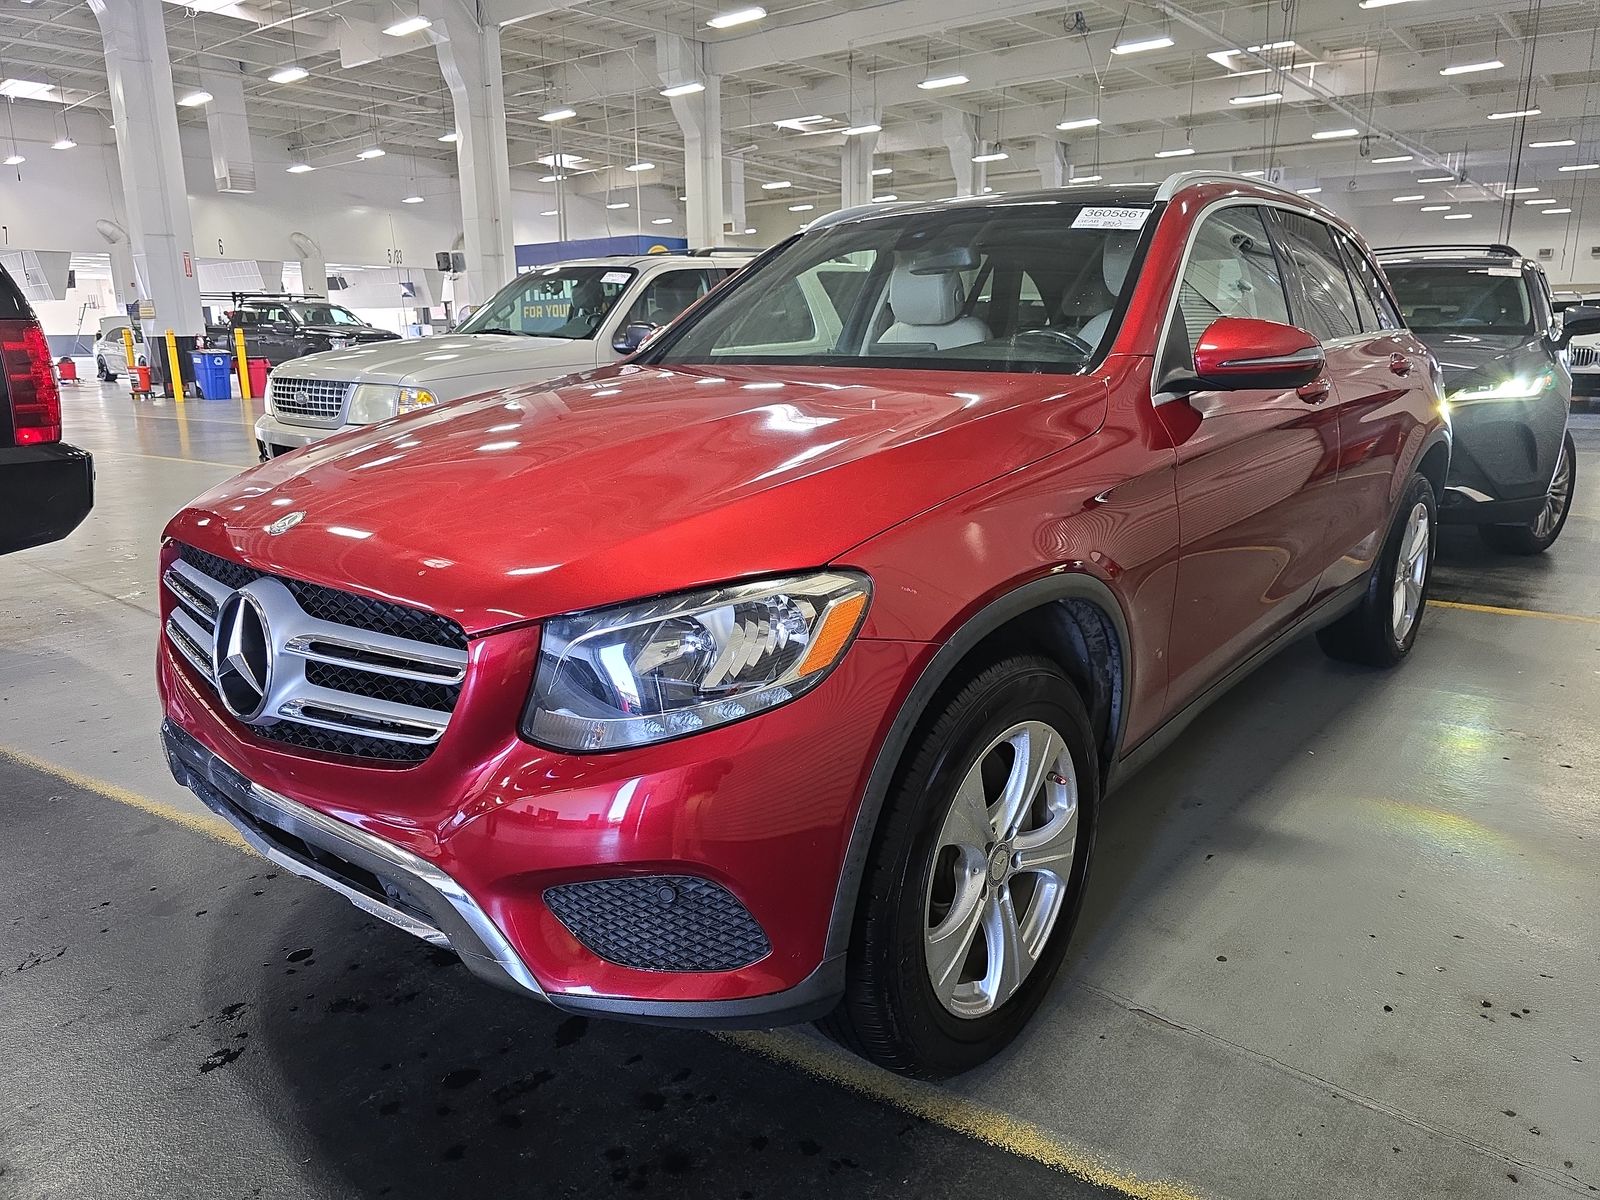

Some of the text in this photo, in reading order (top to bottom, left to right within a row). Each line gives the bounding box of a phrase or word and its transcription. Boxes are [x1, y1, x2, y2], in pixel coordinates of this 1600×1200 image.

[1085, 209, 1145, 218] 3605861
[2, 226, 8, 244] 7
[218, 238, 224, 255] 6
[524, 305, 543, 318] FOR
